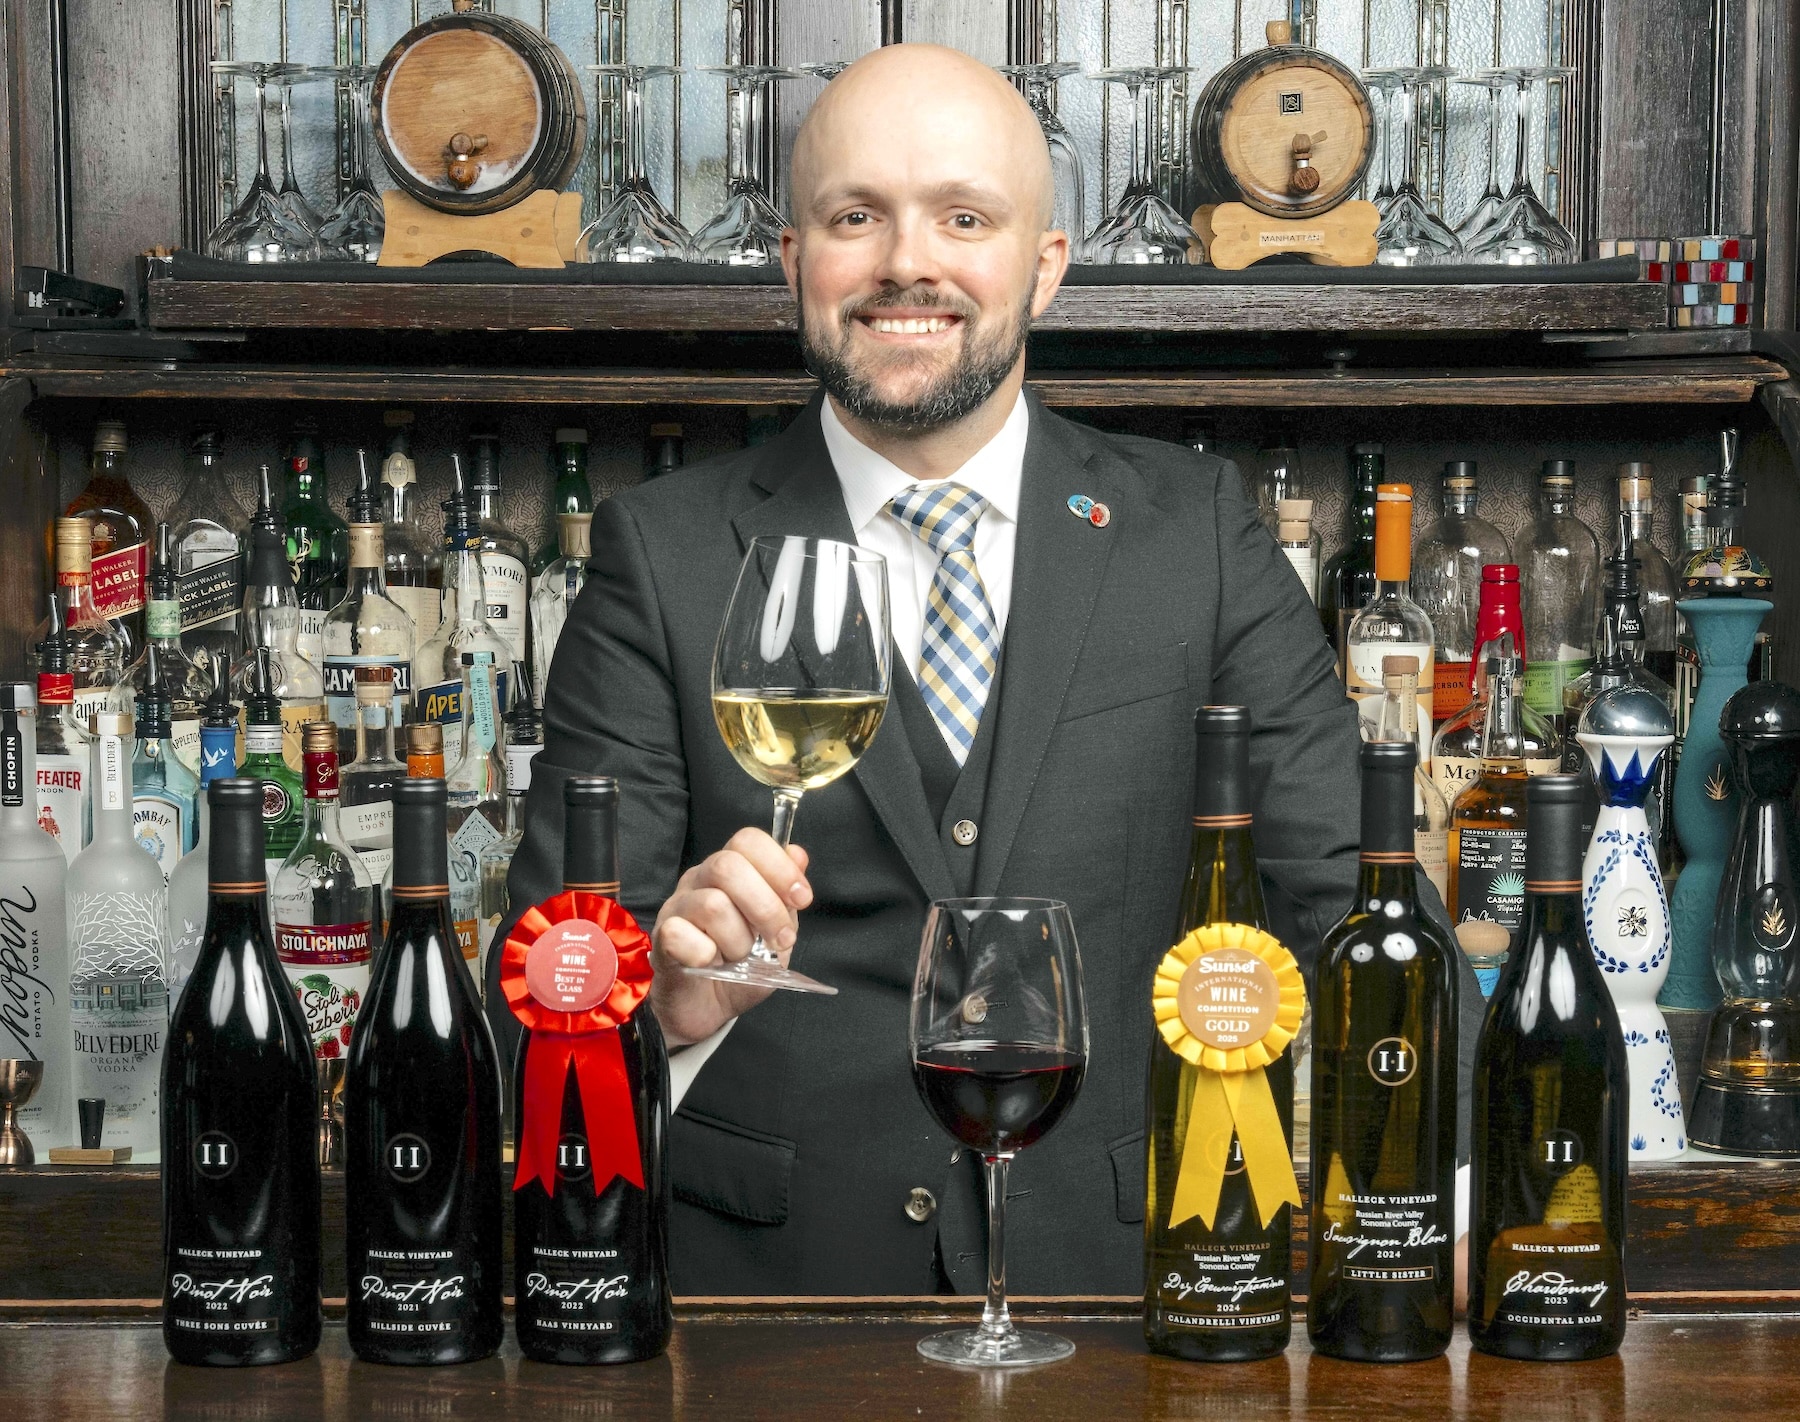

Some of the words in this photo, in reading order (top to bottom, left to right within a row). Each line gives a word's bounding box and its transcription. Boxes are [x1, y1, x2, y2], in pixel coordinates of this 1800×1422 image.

[486, 606, 502, 617] 12
[7, 737, 16, 789] CHOPIN
[132, 810, 171, 827] OMBAY
[361, 821, 385, 831] 1908
[281, 933, 368, 952] STOLICHNAYA
[562, 954, 587, 966] WINE
[1199, 957, 1260, 974] Sunset
[1194, 976, 1264, 994] INTERNATIONAL
[1210, 986, 1247, 1003] WINE
[304, 986, 342, 1018] Stoli
[34, 991, 42, 1038] POTATO
[1197, 1004, 1259, 1014] COMPETITION
[1205, 1019, 1249, 1033] GOLD
[74, 1029, 160, 1054] BELVEDERE
[1217, 1034, 1238, 1043] 2025
[97, 1065, 136, 1073] VODKA
[1338, 1193, 1385, 1204] HALLECK
[1389, 1194, 1437, 1204] VINEYARD
[1355, 1210, 1384, 1219] Russian
[1385, 1211, 1403, 1219] River
[1404, 1211, 1424, 1220] Valley
[1361, 1219, 1391, 1227] Sonoma
[1392, 1219, 1419, 1228] County
[1323, 1222, 1402, 1260] Sauvignon
[1402, 1224, 1448, 1247] Blanc
[533, 1247, 570, 1258] HALLECK
[572, 1249, 618, 1258] VINEYARD
[1184, 1243, 1226, 1252] HALLECK
[1229, 1242, 1271, 1252] VINEYARD
[1512, 1243, 1555, 1253] HALLECK
[1557, 1244, 1601, 1253] VINEYARD
[178, 1248, 214, 1258] HALLECK
[216, 1249, 262, 1258] VINEYARD
[368, 1250, 405, 1260] HALLECK
[408, 1250, 453, 1260] VINEYARD
[1193, 1253, 1221, 1262] Russian
[1222, 1254, 1241, 1262] River
[1241, 1253, 1261, 1263] Valley
[1376, 1250, 1401, 1258] 2024
[1199, 1262, 1229, 1270] Sonoma
[1230, 1262, 1256, 1271] County
[1351, 1269, 1388, 1279] LITTLE
[1392, 1270, 1426, 1279] SISTER
[172, 1273, 233, 1301] Pinot
[229, 1274, 274, 1303] Noir
[361, 1275, 425, 1302] Pinot
[420, 1275, 464, 1304] Noir
[526, 1272, 590, 1300] Pinot
[585, 1274, 629, 1303] Noir
[1503, 1270, 1609, 1308] Chardonnay
[205, 1302, 228, 1310] 2022
[397, 1303, 419, 1312] 2021
[561, 1301, 584, 1310] 2022
[1216, 1304, 1241, 1312] 2024
[176, 1319, 201, 1329] THREE
[204, 1321, 230, 1331] SONS
[234, 1319, 268, 1331] CUVÉE
[536, 1319, 559, 1329] HAAS
[561, 1320, 613, 1331] VINEYARD
[1168, 1314, 1236, 1326] CALANDRELLI
[1239, 1314, 1280, 1326] VINEYARD
[1507, 1314, 1574, 1325] OCCIDENTAL
[1578, 1315, 1602, 1324] ROAD
[370, 1321, 414, 1332] HILLSIDE
[417, 1321, 452, 1332] CUVÉE
